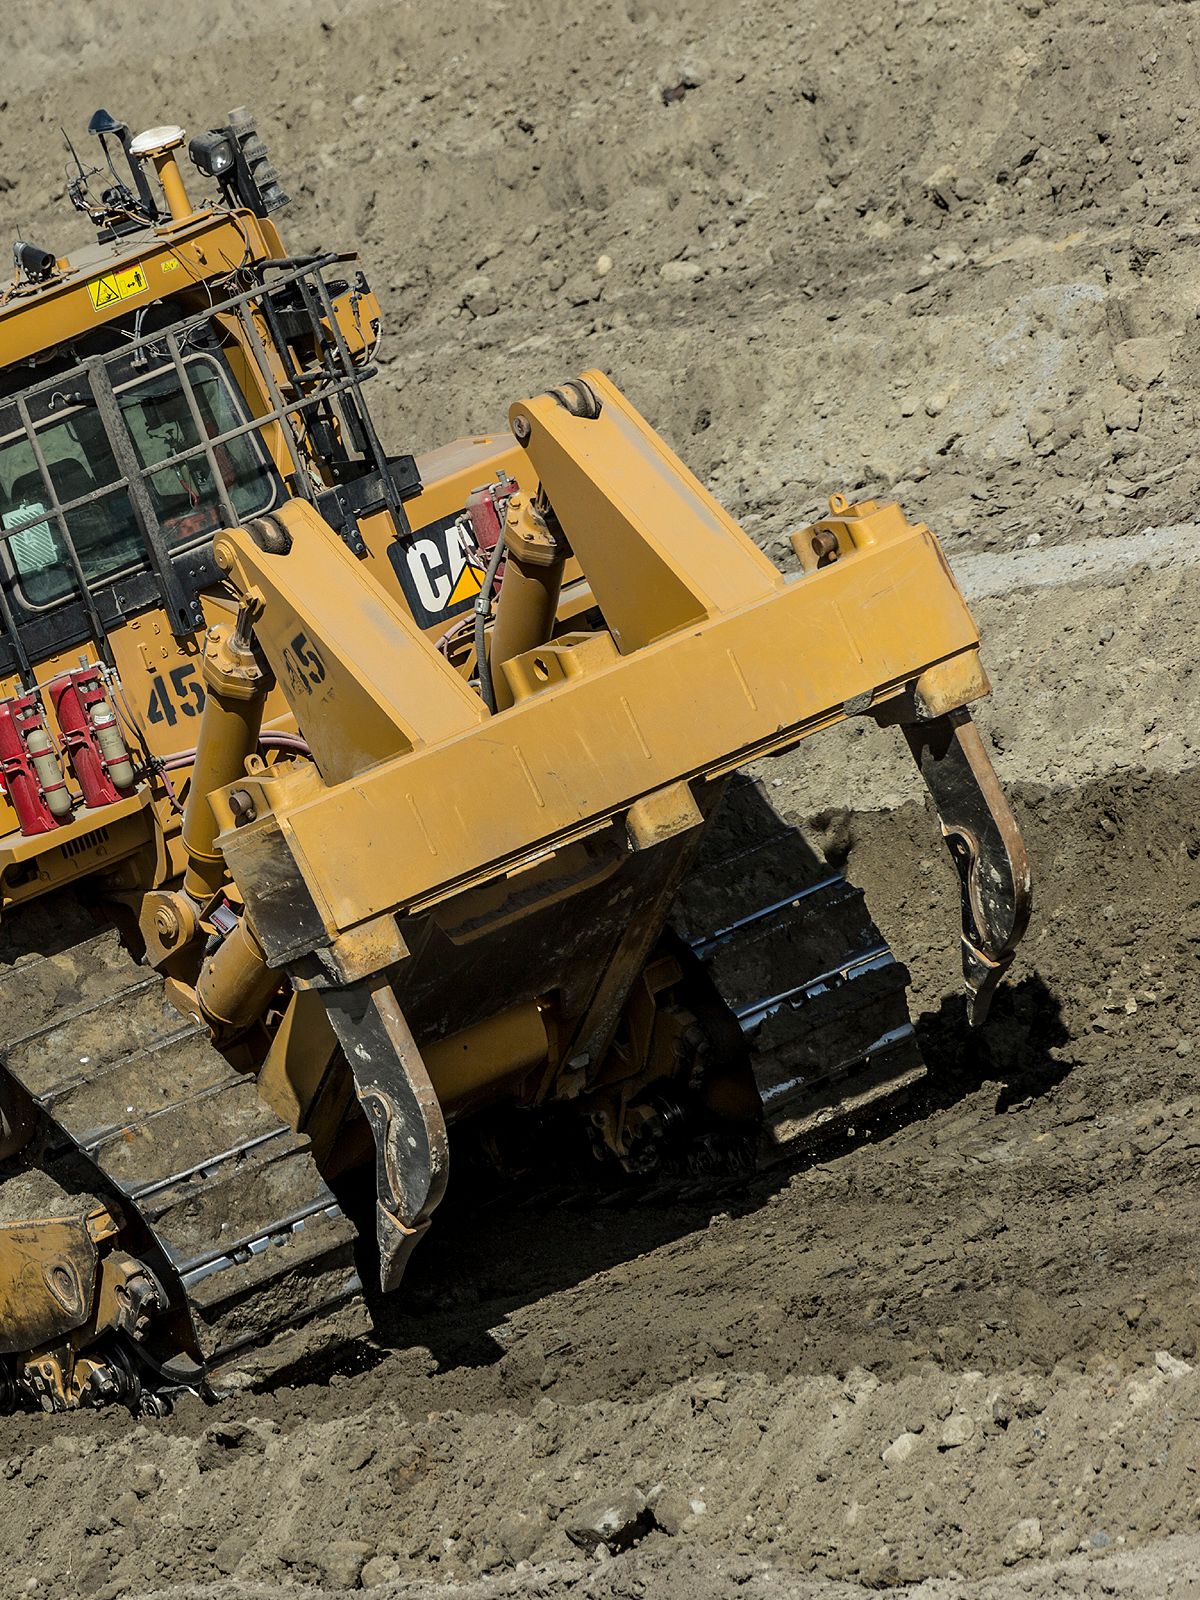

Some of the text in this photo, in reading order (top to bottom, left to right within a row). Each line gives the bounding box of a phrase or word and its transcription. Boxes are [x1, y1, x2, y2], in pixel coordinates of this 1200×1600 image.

[407, 521, 488, 613] CA
[147, 663, 206, 727] 45
[283, 632, 326, 696] 45
